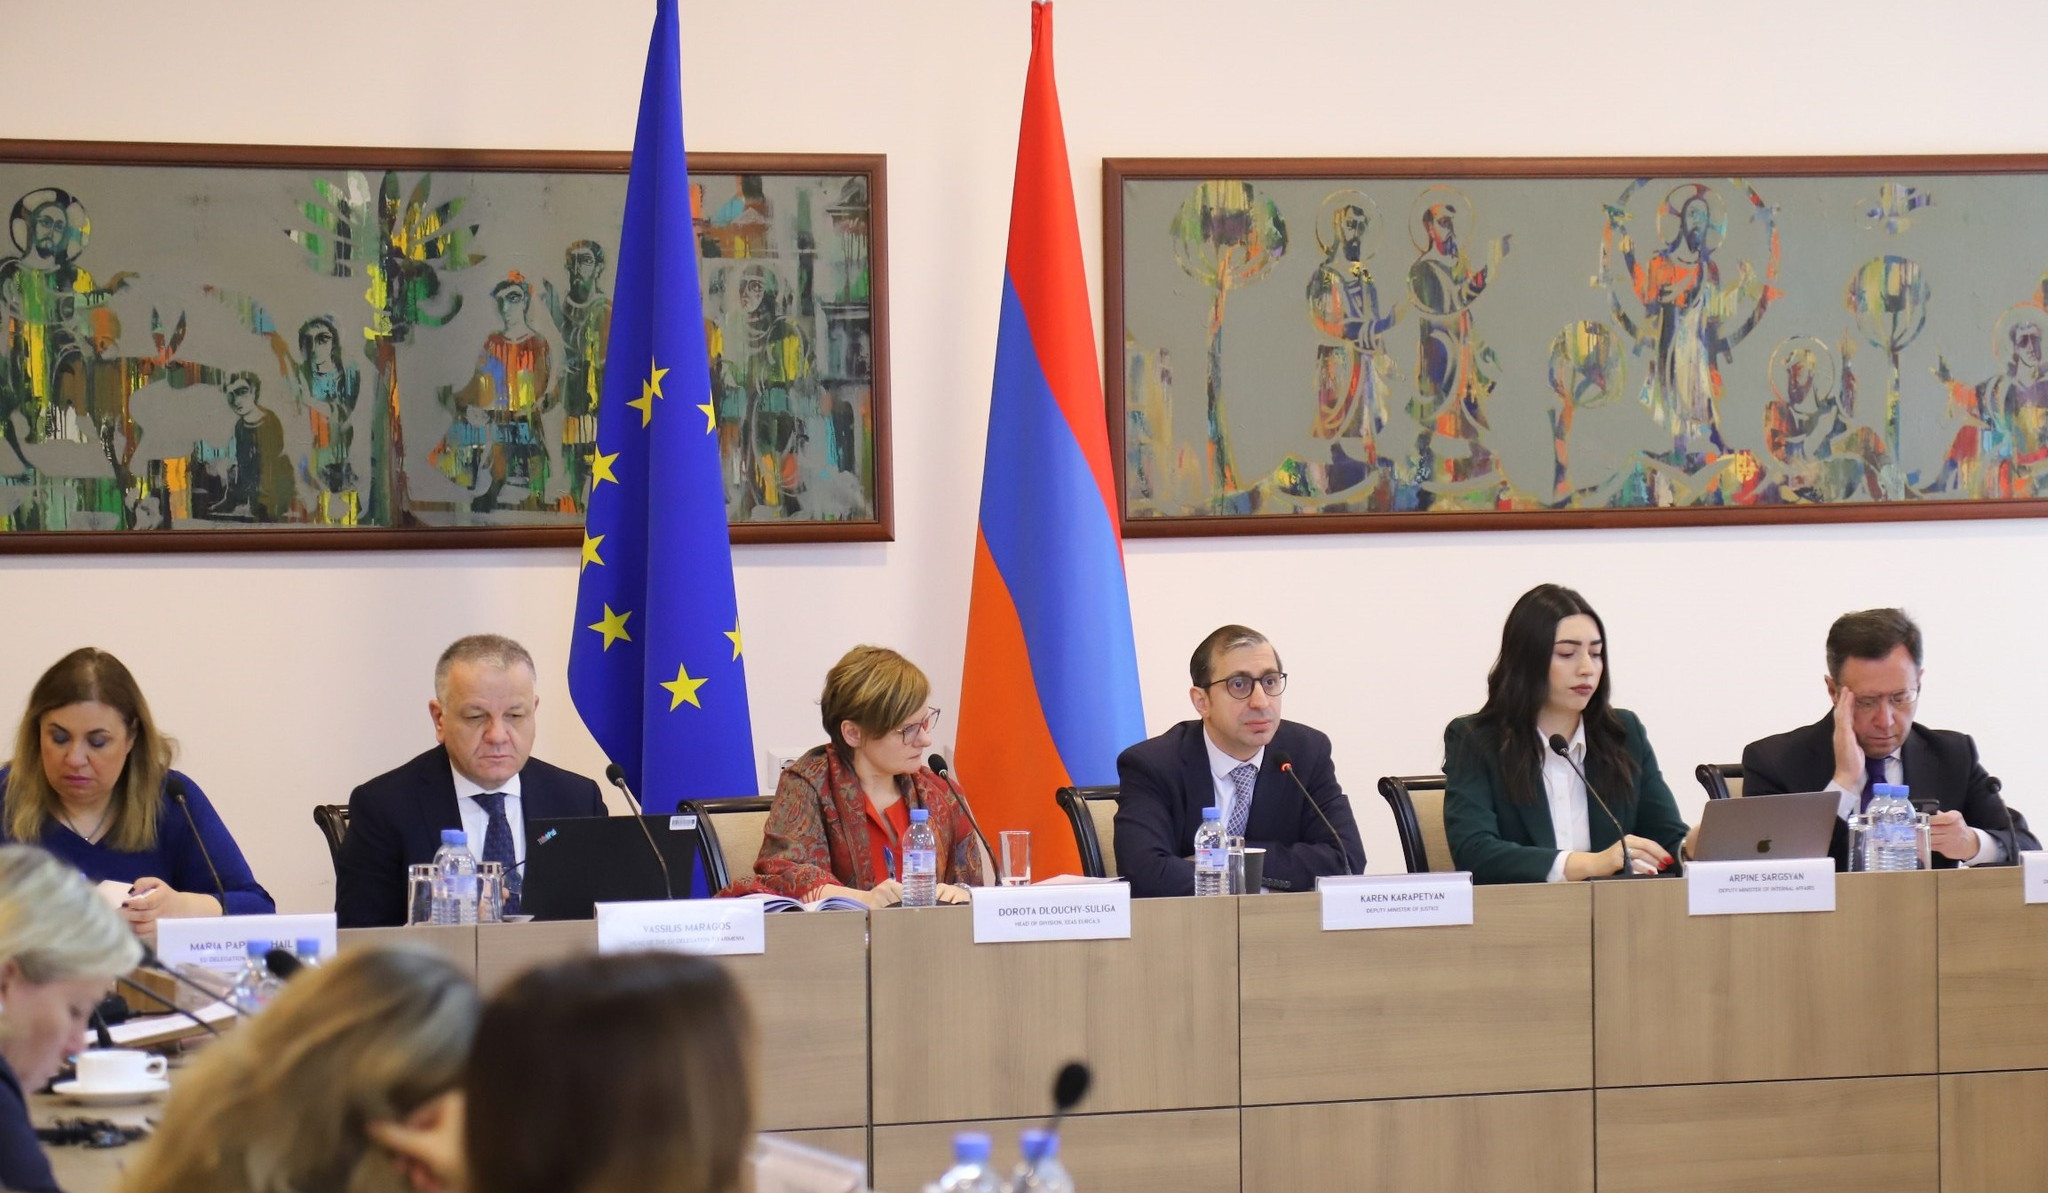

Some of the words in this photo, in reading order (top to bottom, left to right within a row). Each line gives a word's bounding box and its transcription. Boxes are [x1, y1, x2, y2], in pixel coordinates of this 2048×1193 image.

[1729, 874, 1758, 882] ARPINE
[1761, 872, 1804, 881] SARGSYAN
[1391, 892, 1445, 901] KARAPETYAN
[998, 907, 1036, 916] DOROTA
[1039, 904, 1116, 915] DLOUCHY-SULIGA
[643, 924, 682, 934] VASSILIS
[685, 921, 731, 932] MARAGOS
[190, 942, 222, 951] MARIA
[225, 940, 293, 950] PAPHAIL
